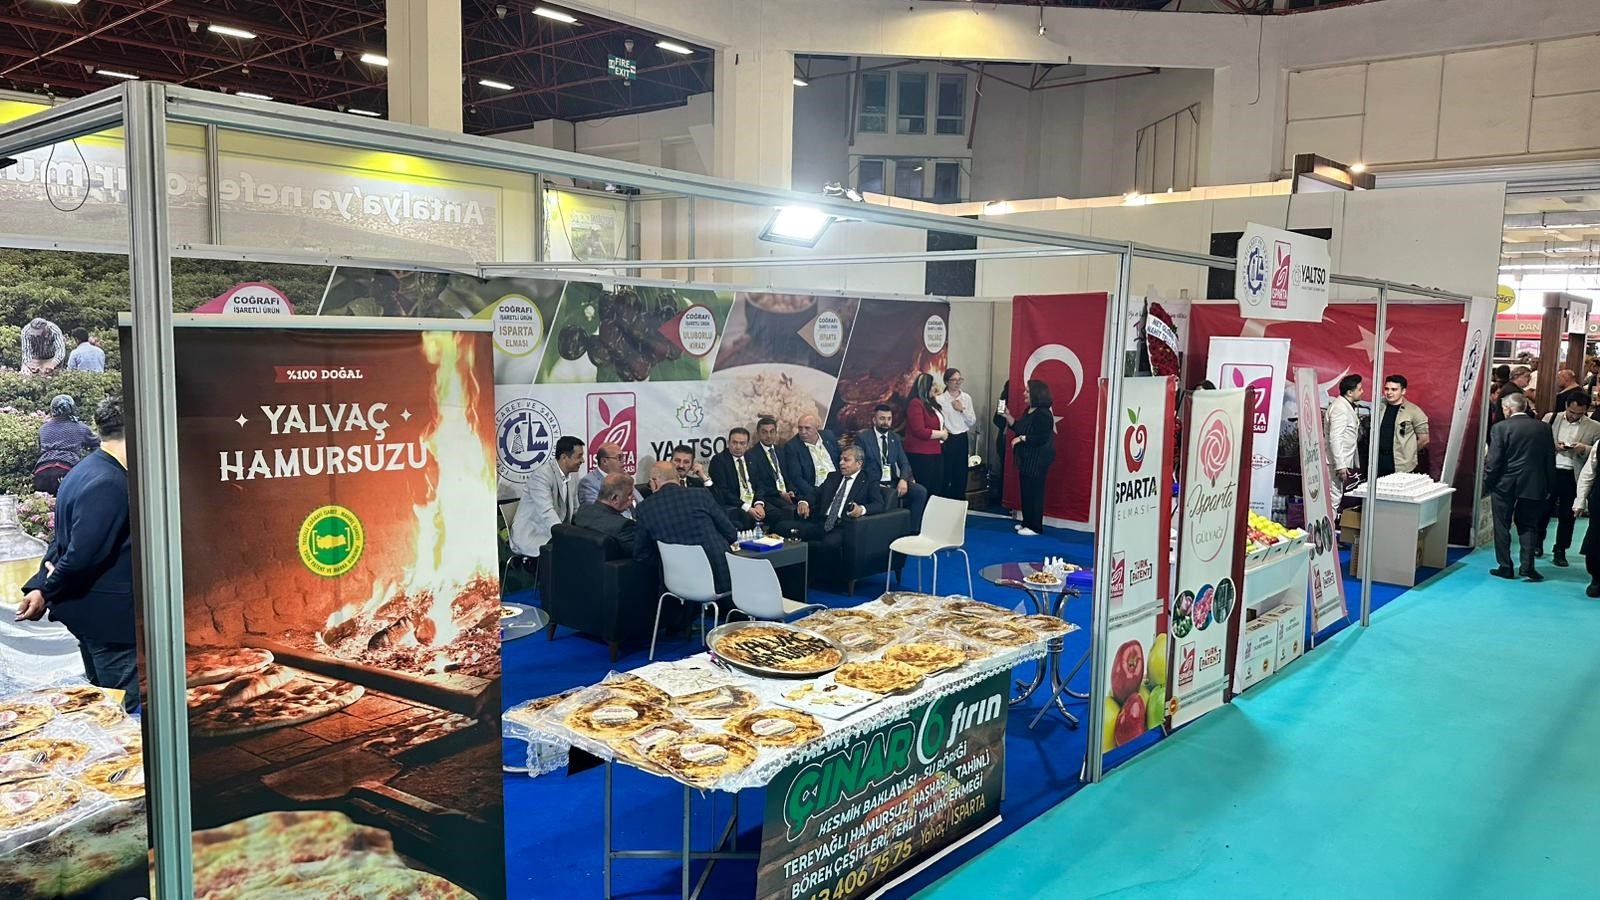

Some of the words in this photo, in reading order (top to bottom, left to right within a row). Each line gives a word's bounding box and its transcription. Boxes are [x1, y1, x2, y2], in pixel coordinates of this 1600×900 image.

[615, 57, 630, 68] FIRE
[615, 66, 630, 79] EXIT
[1301, 265, 1326, 285] YALTSO
[233, 295, 280, 305] COĞRAFİ
[233, 306, 262, 314] İŞARETLİ
[263, 306, 280, 314] ÜRÜN
[499, 305, 533, 313] COĞRAFİ
[499, 326, 534, 336] ISPARTA
[505, 339, 529, 348] ELMASI
[286, 369, 318, 380] %100
[321, 366, 363, 379] DOĞAL
[261, 403, 390, 440] YALVAÇ
[219, 442, 428, 481] HAMURSUZU
[588, 451, 635, 468] ISTA
[1115, 477, 1157, 504] SPARTA
[1187, 481, 1237, 524] Isparta
[1117, 506, 1151, 521] ELMASI
[1132, 567, 1151, 581] PATENT
[786, 723, 915, 839] ÇINAR
[946, 694, 1002, 748] fırın
[818, 803, 861, 837] KESMİK
[863, 773, 917, 813] BAKLAVASI
[923, 762, 936, 780] SU
[936, 741, 967, 772] BÖREĞİ
[783, 832, 849, 878] TEREYAĞLI
[955, 749, 990, 779] TAHİNLİ
[791, 863, 833, 899] BÖREK
[891, 810, 918, 839] TEKLİ
[918, 793, 949, 823] YALVAÇ
[949, 771, 983, 802] EKMEĞİ
[832, 864, 868, 899] 406
[871, 850, 889, 879] 75
[892, 837, 913, 864] 75
[920, 820, 945, 846] Yalvaç
[951, 793, 985, 826] ISPARTA
